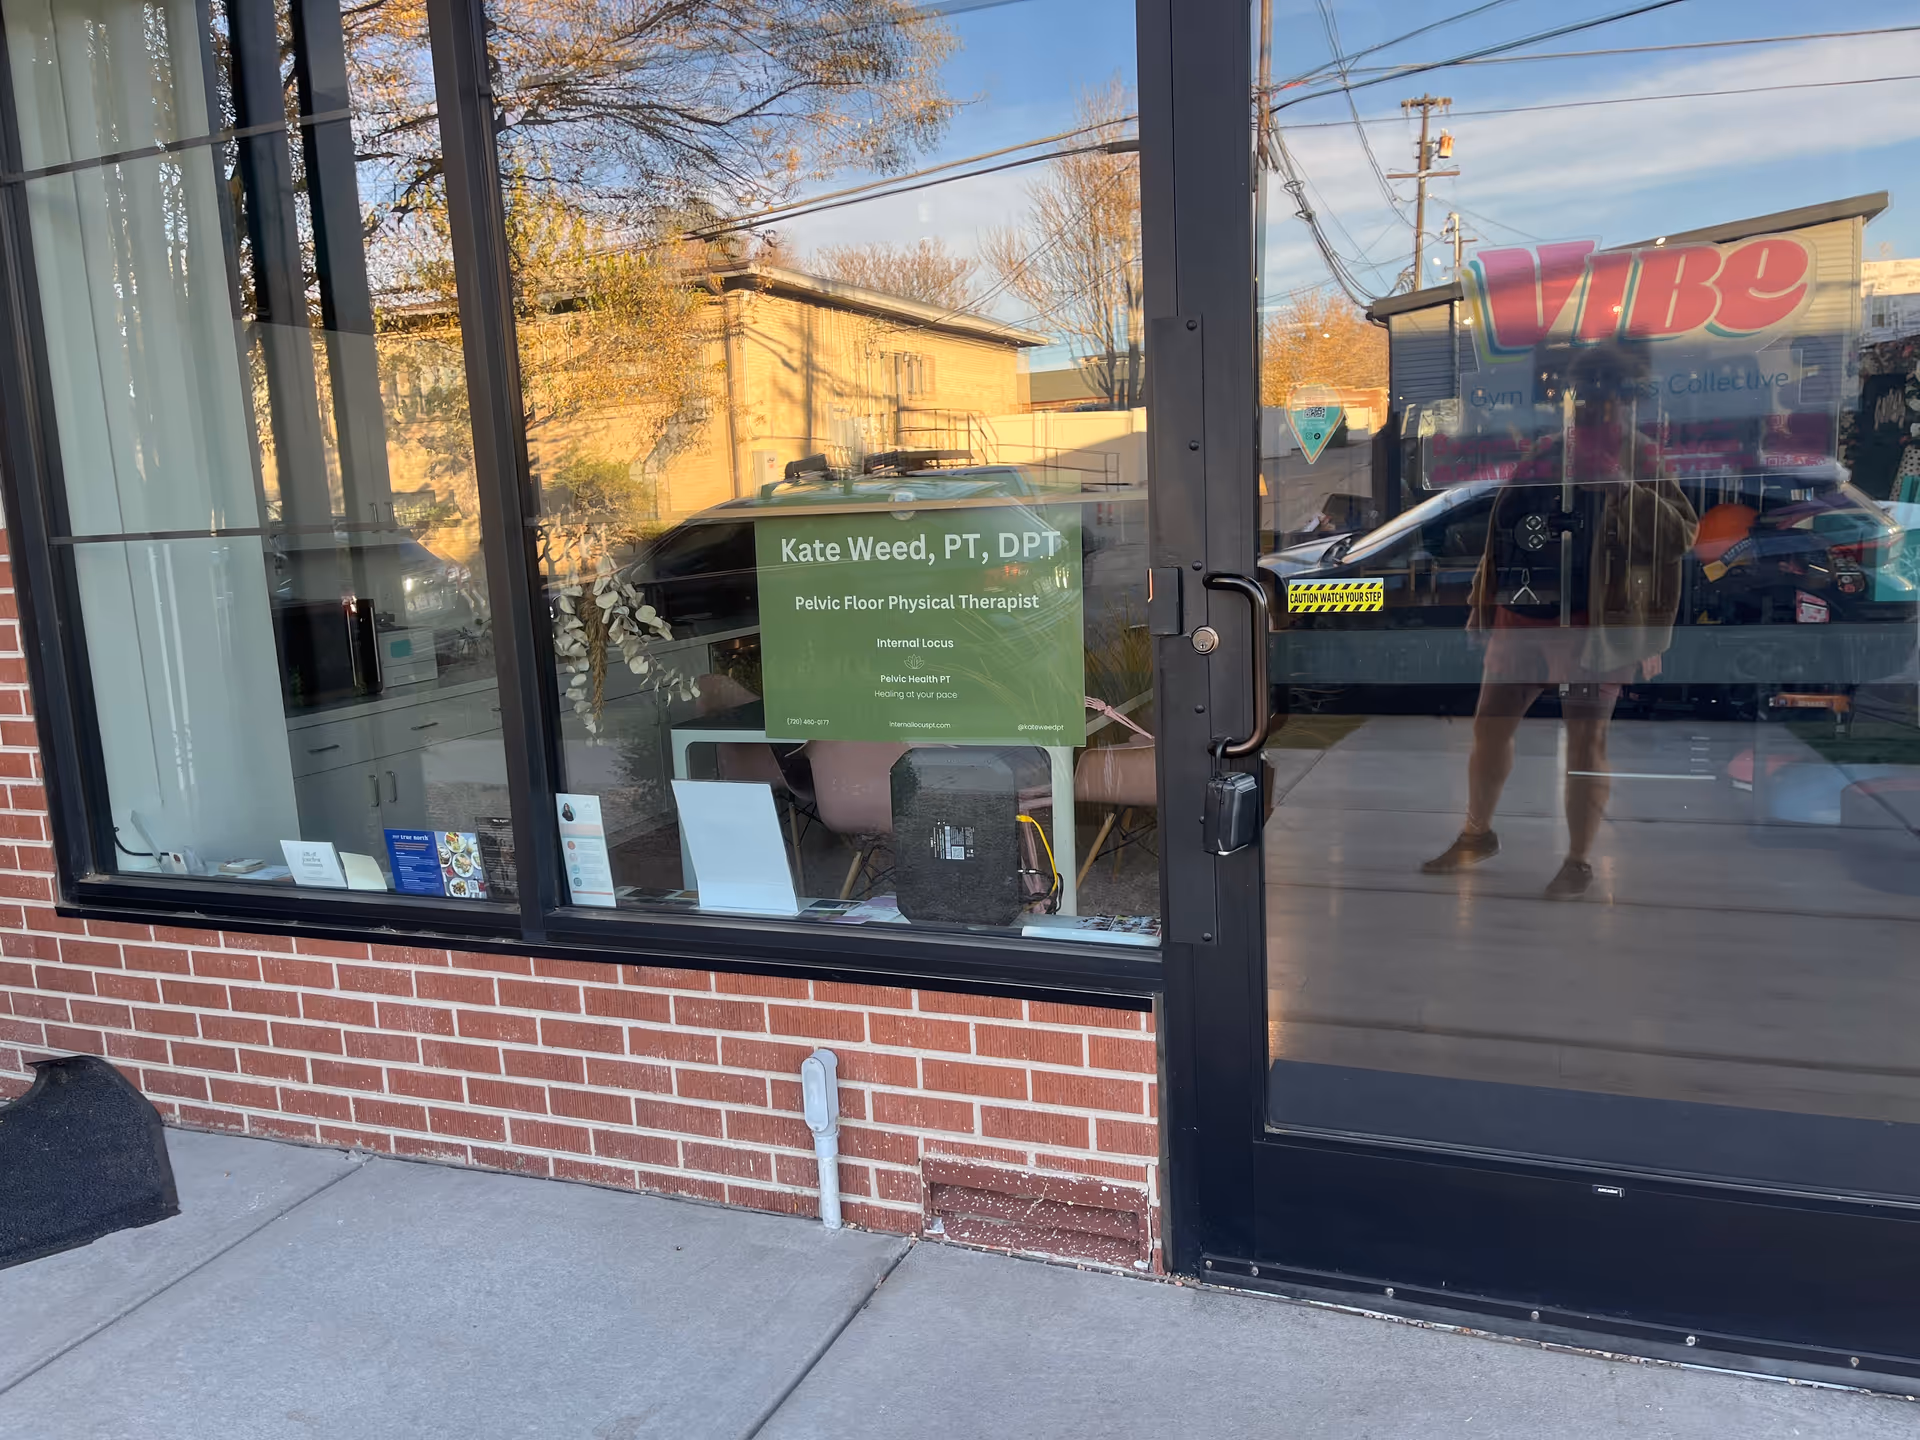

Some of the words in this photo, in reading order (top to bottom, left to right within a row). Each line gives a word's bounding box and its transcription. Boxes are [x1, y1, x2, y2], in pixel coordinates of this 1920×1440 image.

[1471, 387, 1522, 411] Gym
[1668, 368, 1789, 396] Collective
[781, 538, 841, 563] Kate
[848, 534, 935, 566] Weed,
[944, 533, 989, 564] PT,
[998, 531, 1061, 558] DPT
[1290, 593, 1319, 604] CAUTION
[1320, 592, 1344, 603] WATCH
[1345, 592, 1364, 603] YOUR
[1365, 591, 1382, 602] STEP
[795, 595, 841, 611] Pelvic
[844, 595, 884, 611] Floor
[888, 594, 956, 614] Physical
[958, 593, 1040, 613] Therapist
[876, 638, 920, 648] Internal
[922, 638, 954, 648] Locus
[880, 674, 907, 683] Pelvic
[908, 675, 938, 684] Health
[940, 675, 951, 684] PT
[874, 690, 905, 700] Healing
[916, 691, 934, 700] your
[936, 692, 958, 700] pace
[786, 717, 803, 726] (720)
[889, 721, 951, 730] internallocuspt.com
[1017, 724, 1064, 732] @kateweedpt
